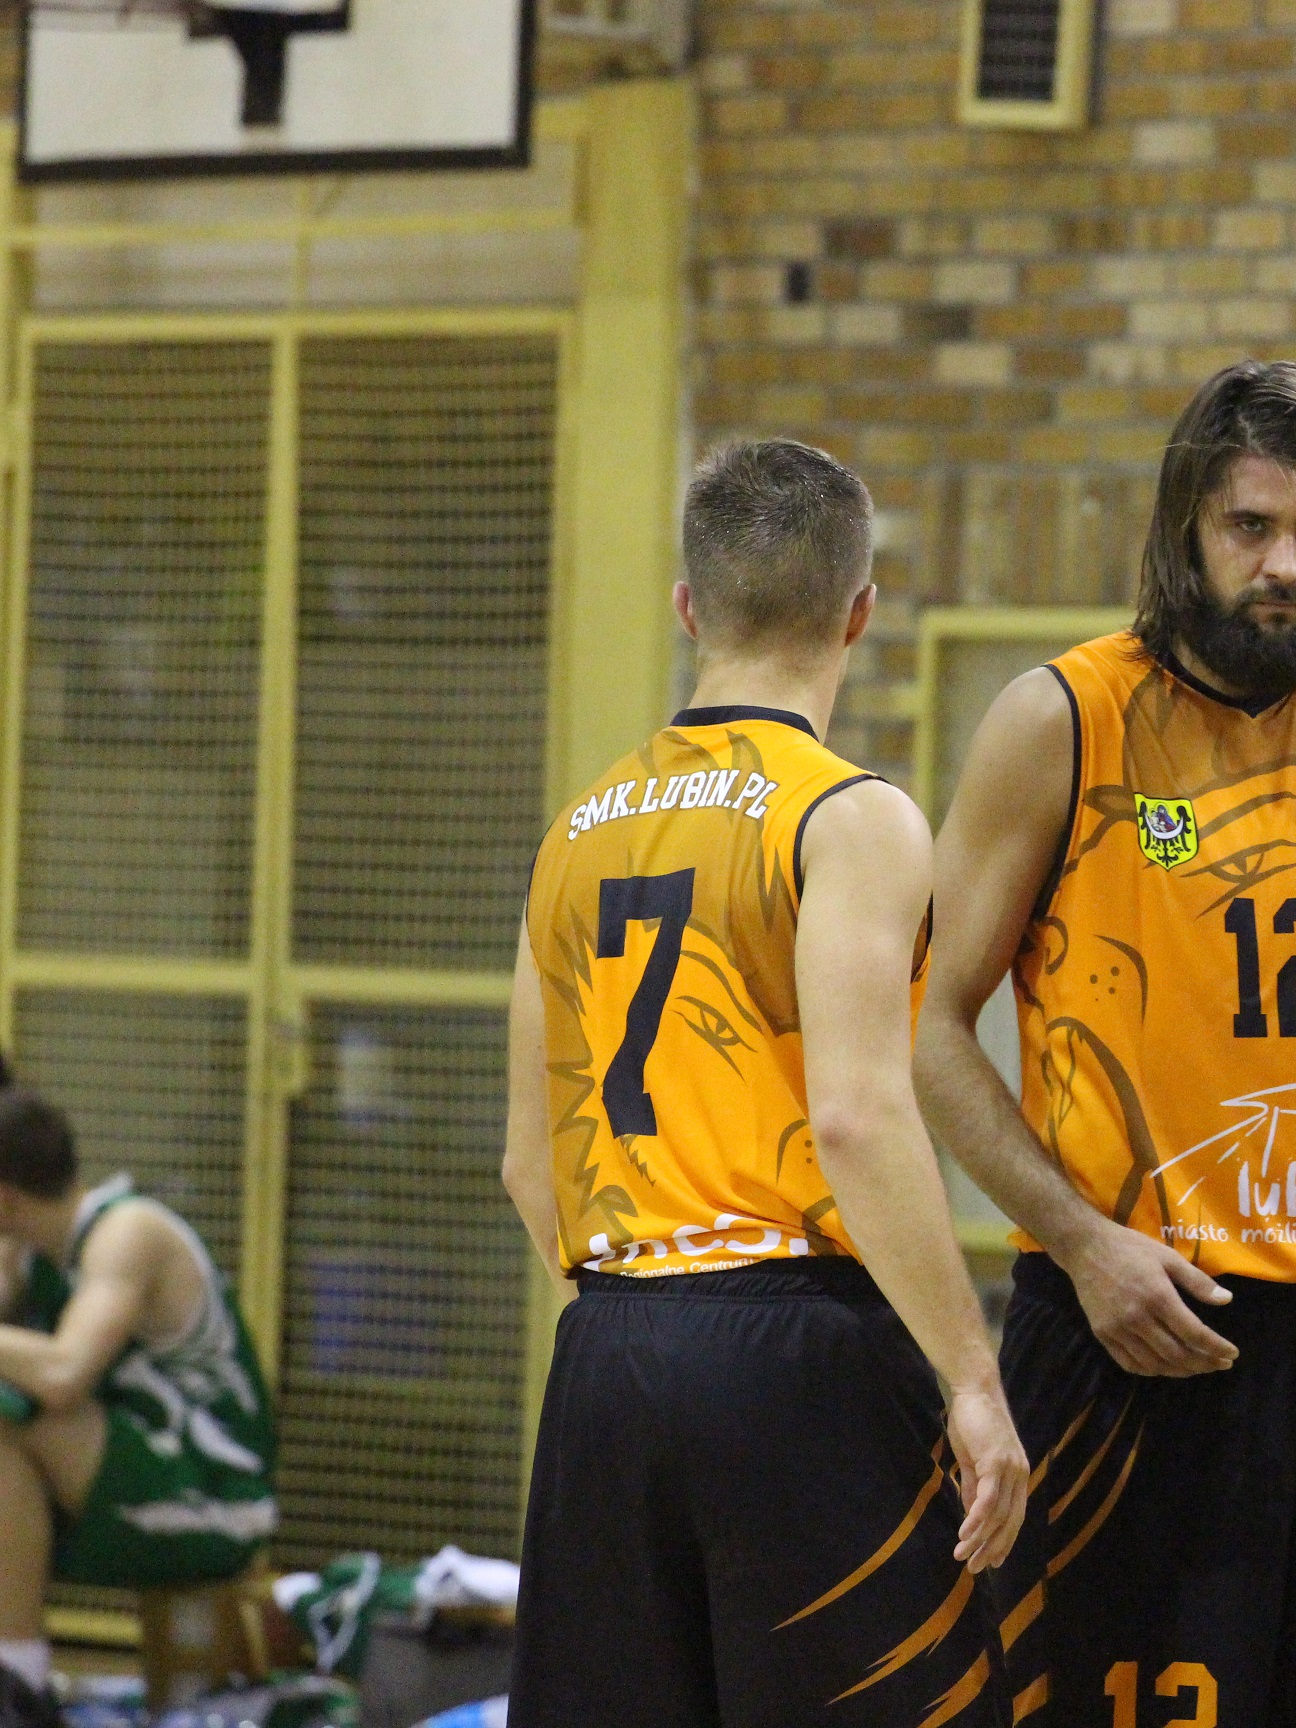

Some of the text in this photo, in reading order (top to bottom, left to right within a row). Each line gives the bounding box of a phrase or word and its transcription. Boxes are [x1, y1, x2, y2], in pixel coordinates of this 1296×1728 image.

[566, 768, 779, 841] SMK.LUBIN.PL
[597, 867, 695, 1139] 7
[1160, 1218, 1229, 1243] miasto
